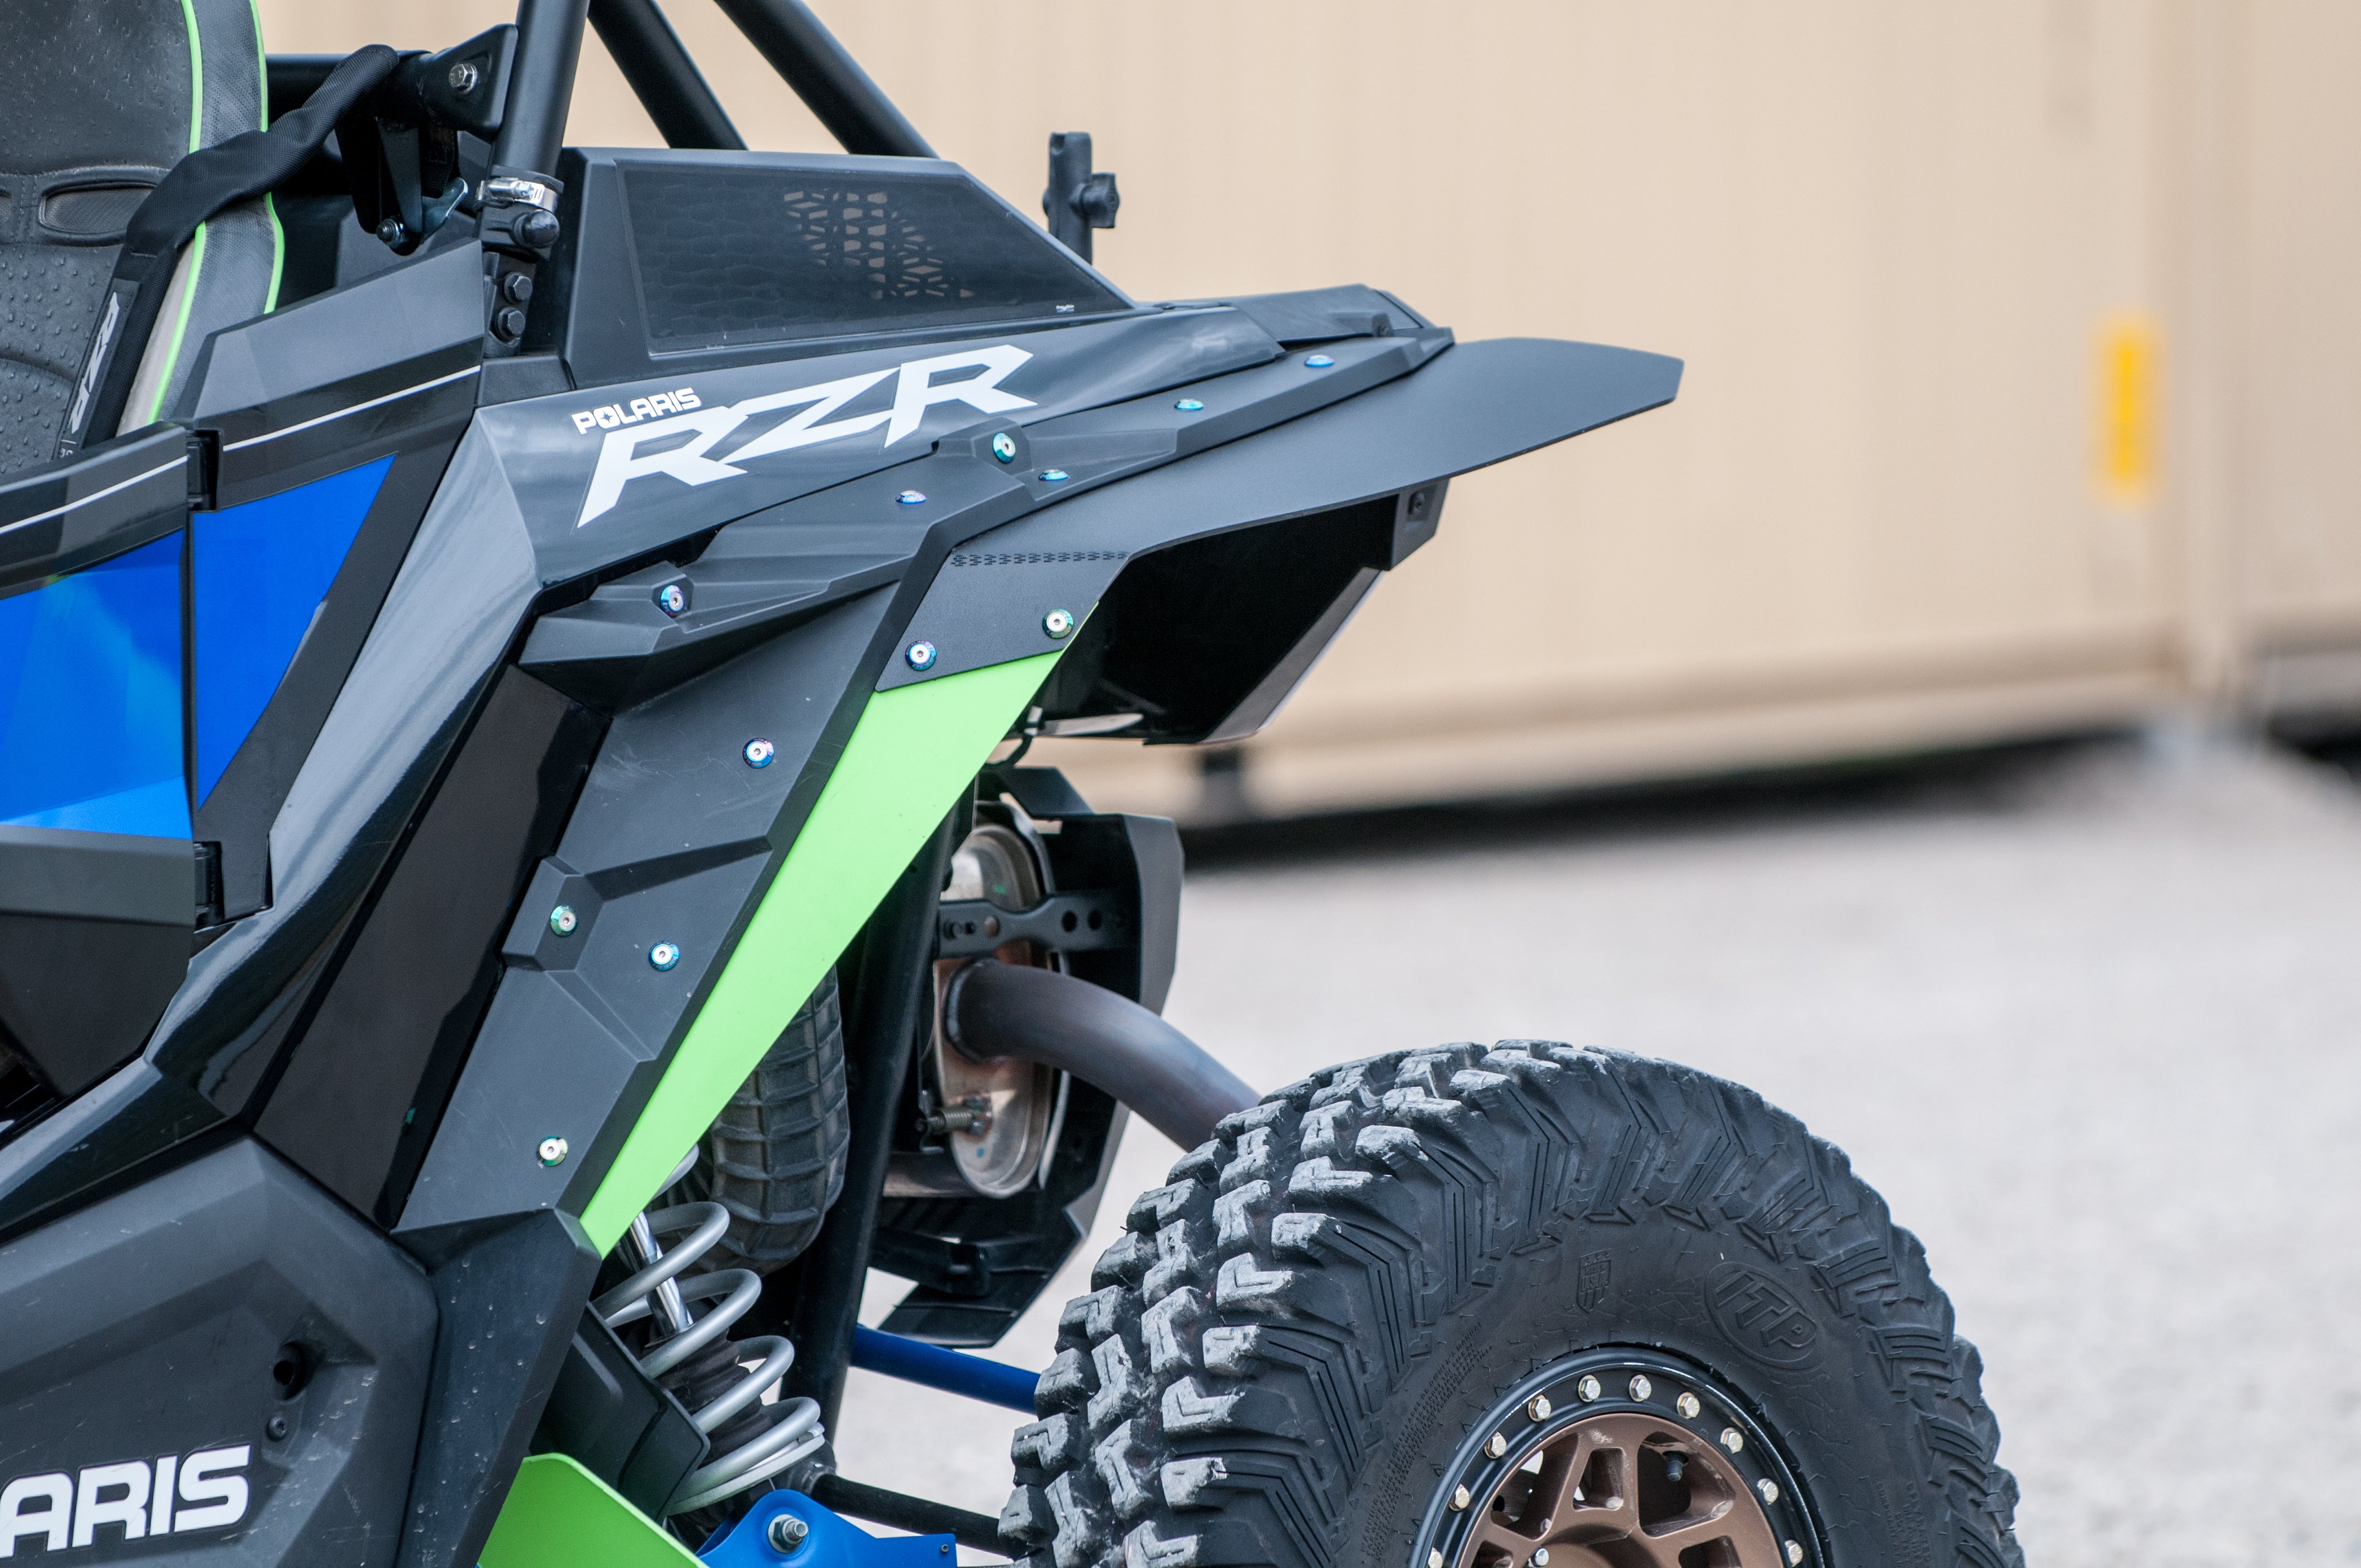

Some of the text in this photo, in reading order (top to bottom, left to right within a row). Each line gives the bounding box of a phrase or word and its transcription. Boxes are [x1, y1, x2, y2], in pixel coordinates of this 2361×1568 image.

[68, 292, 119, 434] RZR
[571, 387, 701, 436] POLARIS
[576, 344, 1038, 529] RZR
[1713, 1270, 1818, 1348] ITP
[0, 1444, 251, 1558] ARIS
